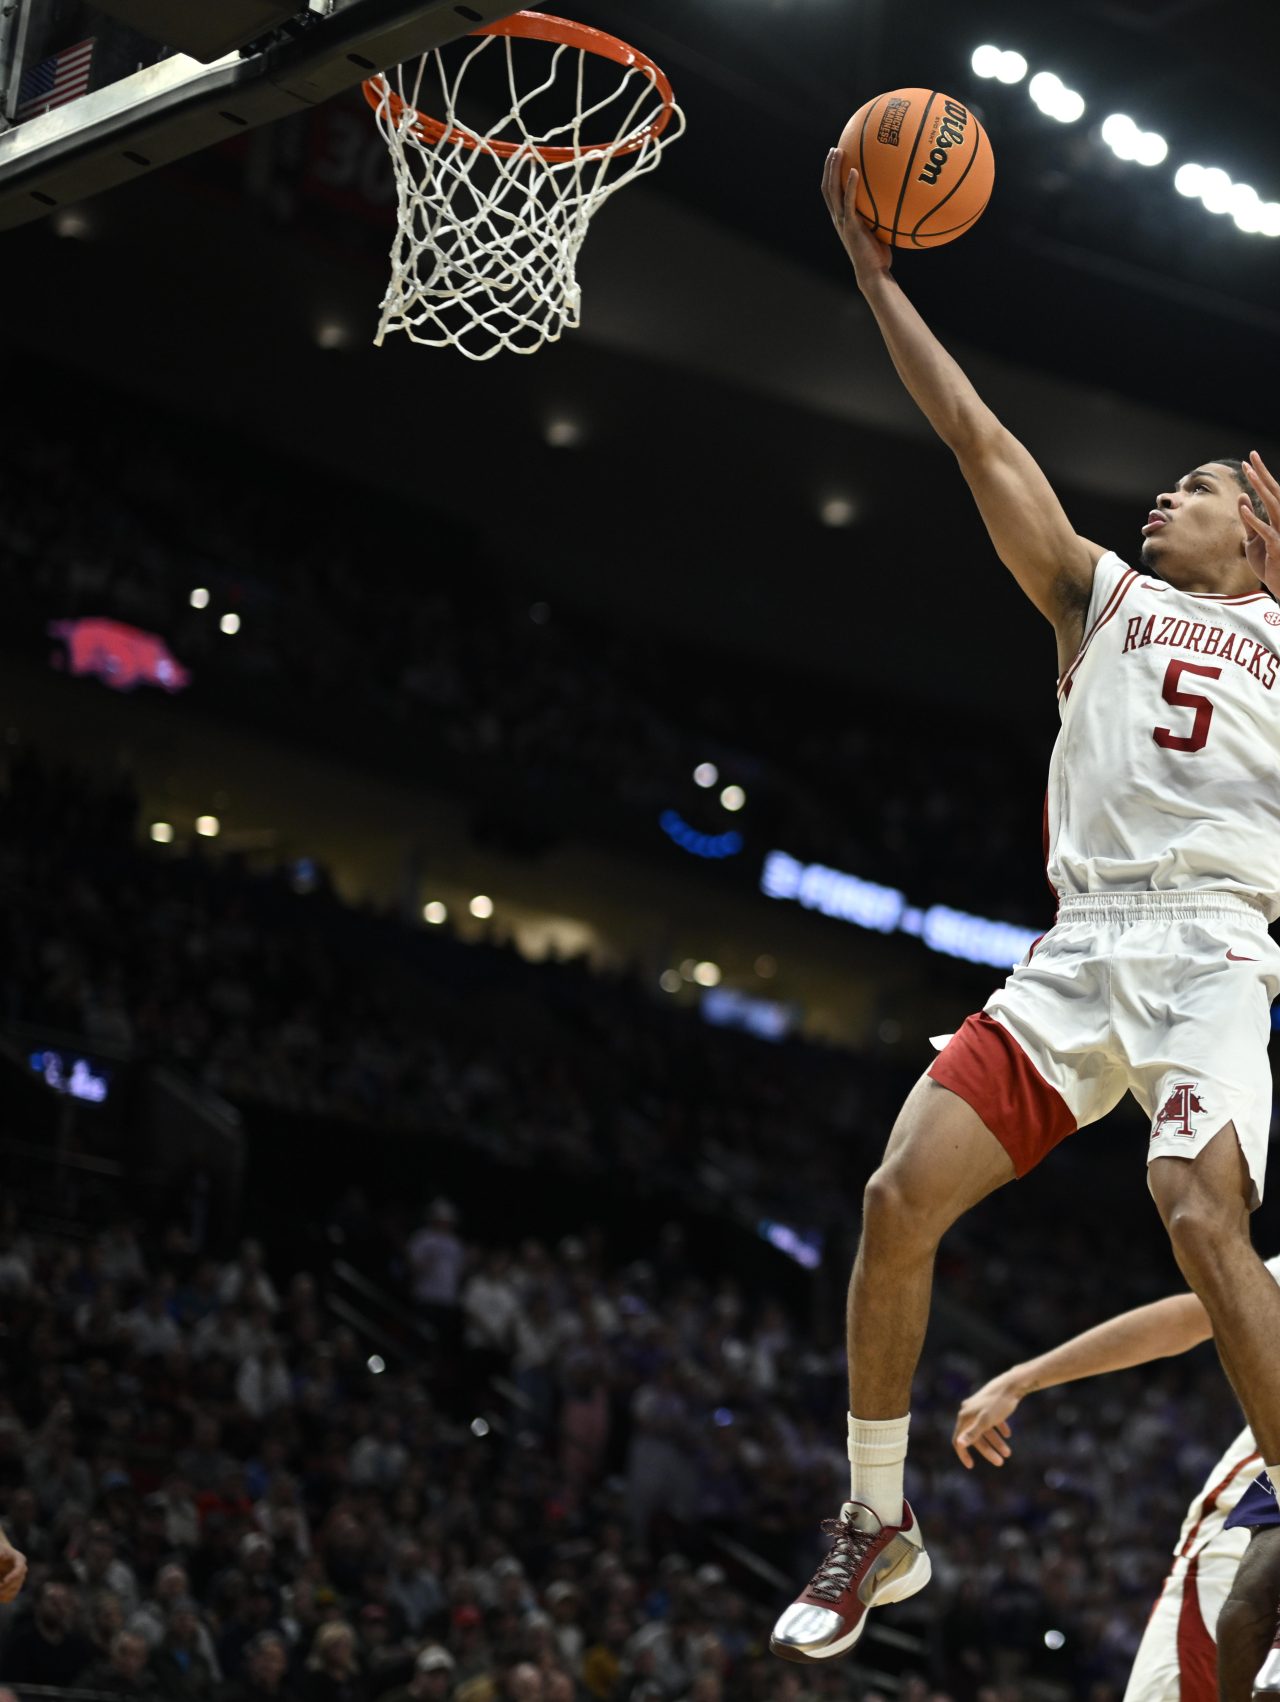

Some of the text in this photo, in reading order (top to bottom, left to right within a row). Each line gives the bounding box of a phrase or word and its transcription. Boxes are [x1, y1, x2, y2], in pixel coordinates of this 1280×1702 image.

[918, 100, 968, 186] Wilson
[1122, 614, 1280, 690] RAZORBACKS
[1153, 658, 1222, 753] 5
